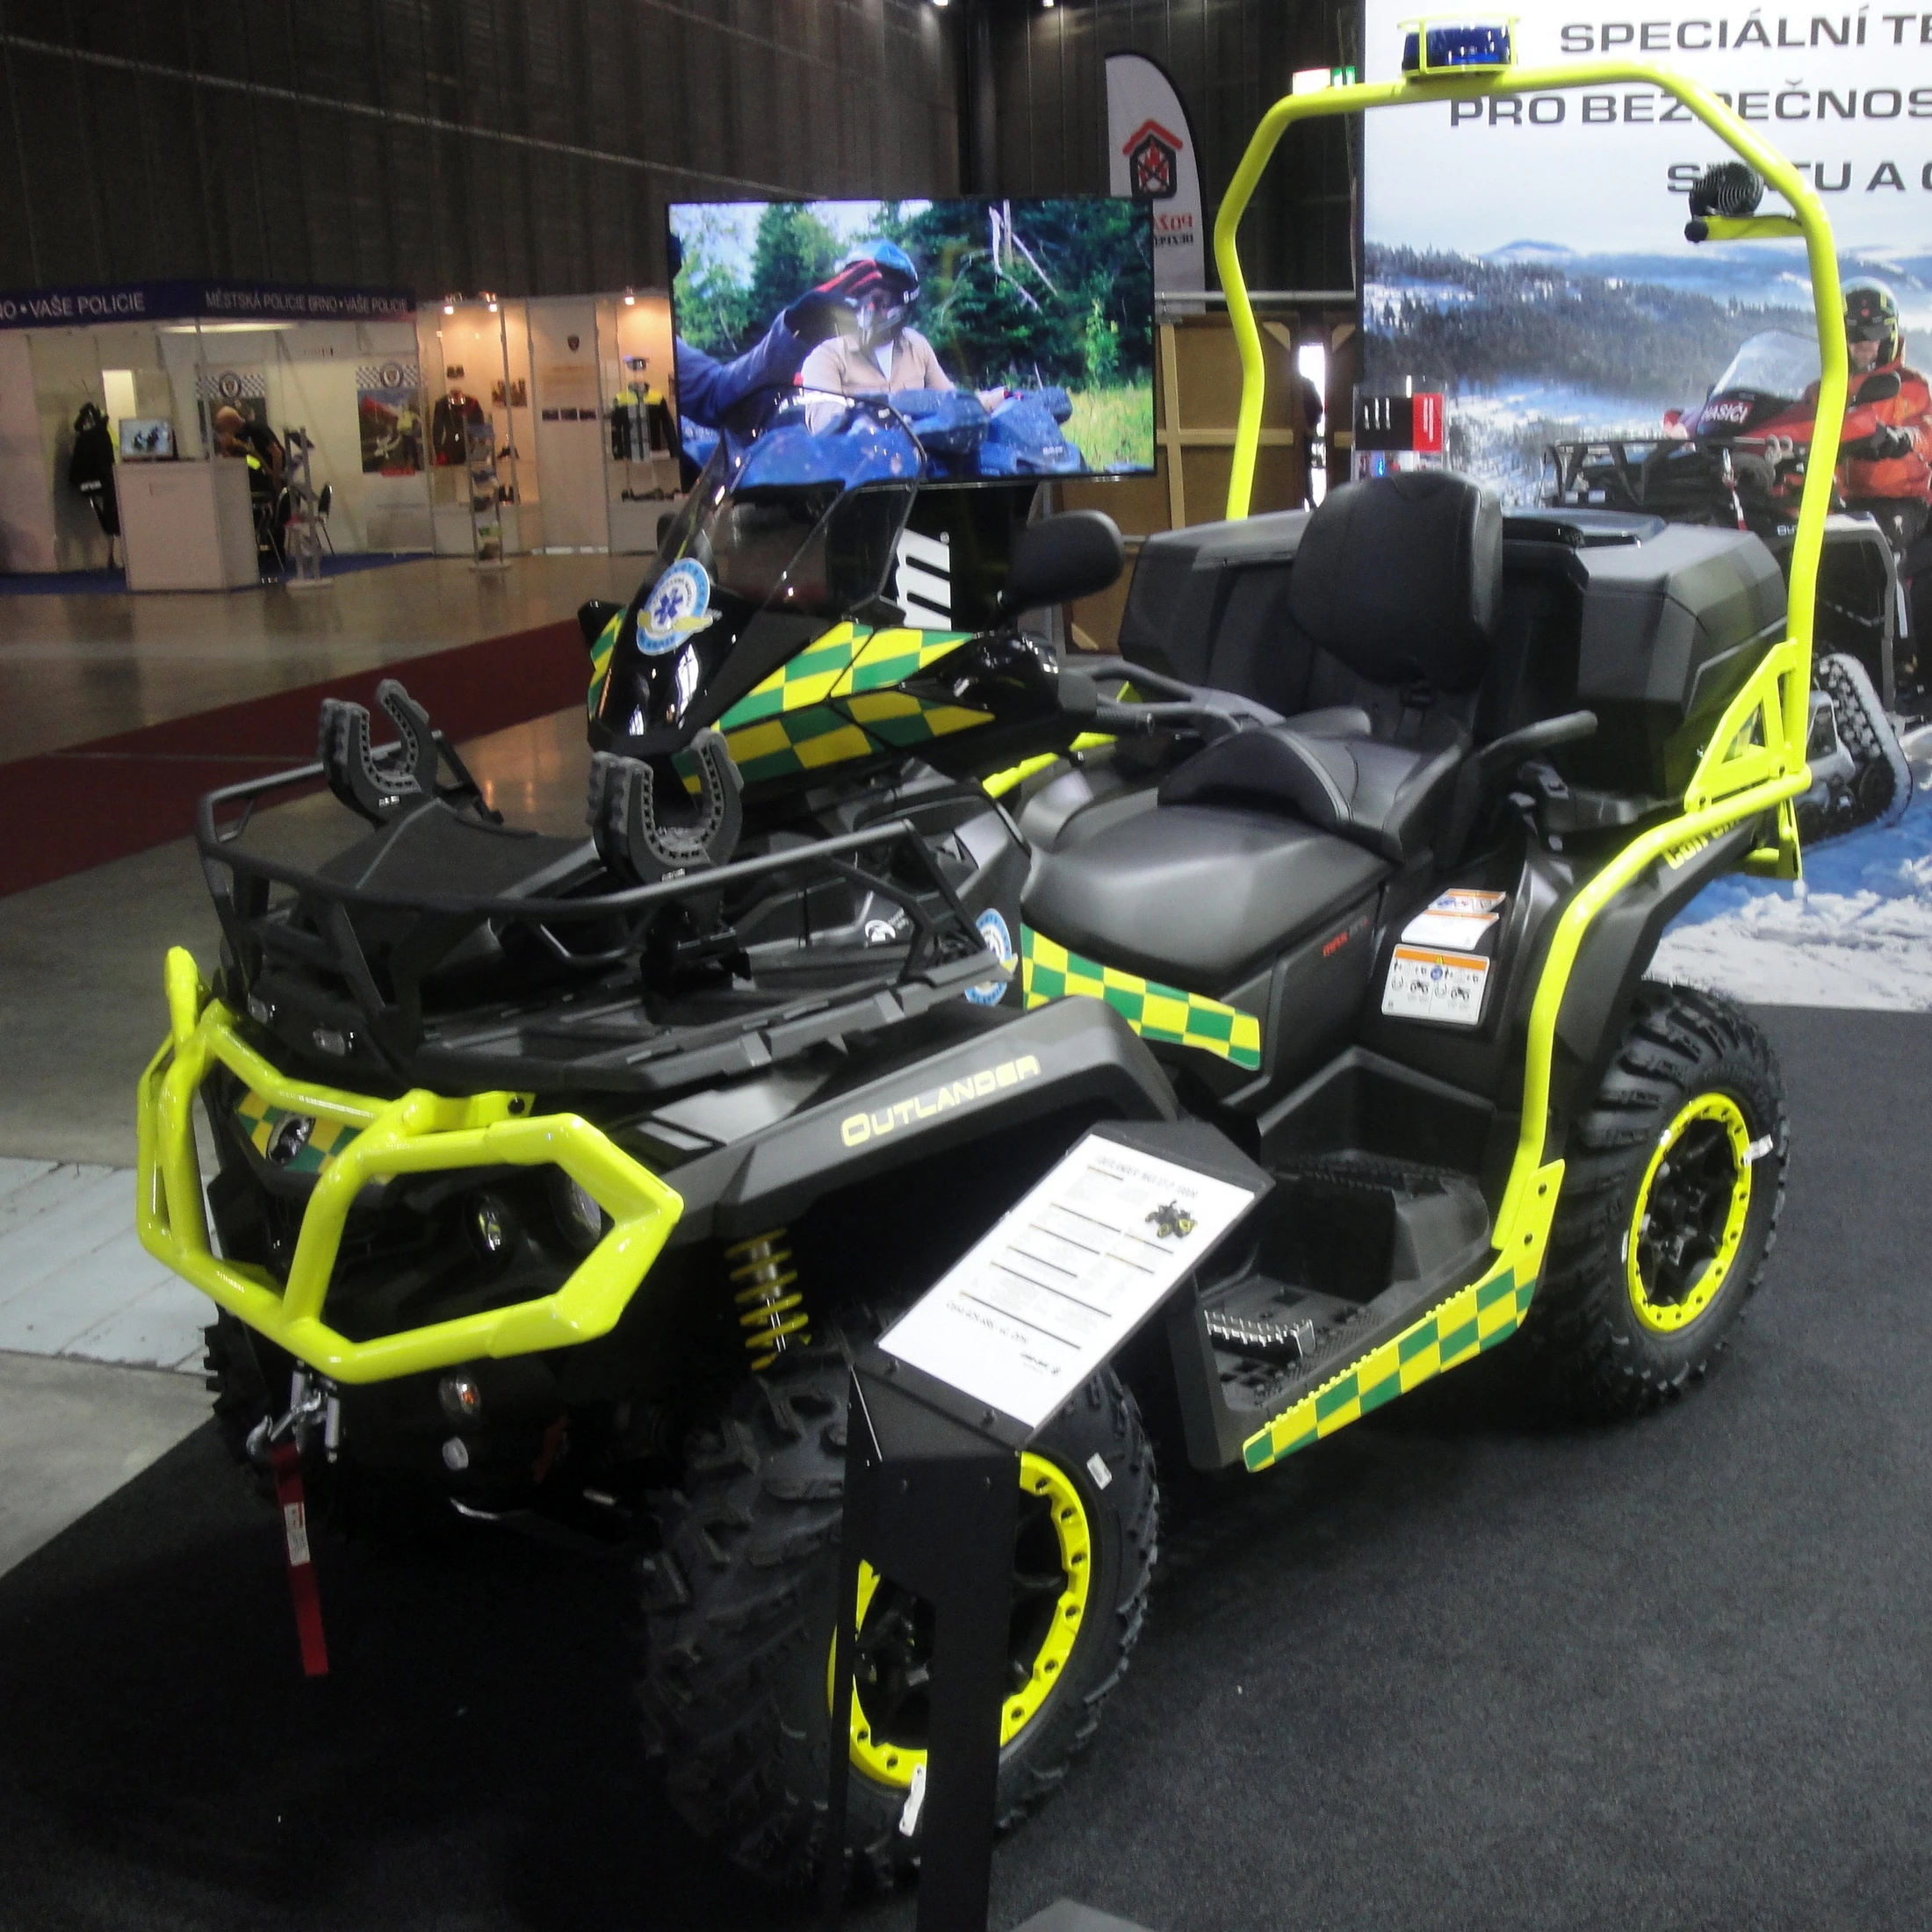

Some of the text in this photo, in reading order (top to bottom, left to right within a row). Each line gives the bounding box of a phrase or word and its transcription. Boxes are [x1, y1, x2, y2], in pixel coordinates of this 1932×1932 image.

[1561, 4, 1870, 52] SPECIÁLNÍ
[1451, 79, 1932, 126] PRO BEZEČNOS
[1866, 161, 1907, 191] A
[0, 291, 145, 321] O VAŠE POLICIE
[205, 289, 407, 314] MĚSTSKÁ POLICIE BRNO VAŠE POLICIE
[1701, 400, 1748, 423] HASIČI
[841, 1055, 1042, 1148] OUTLANDER
